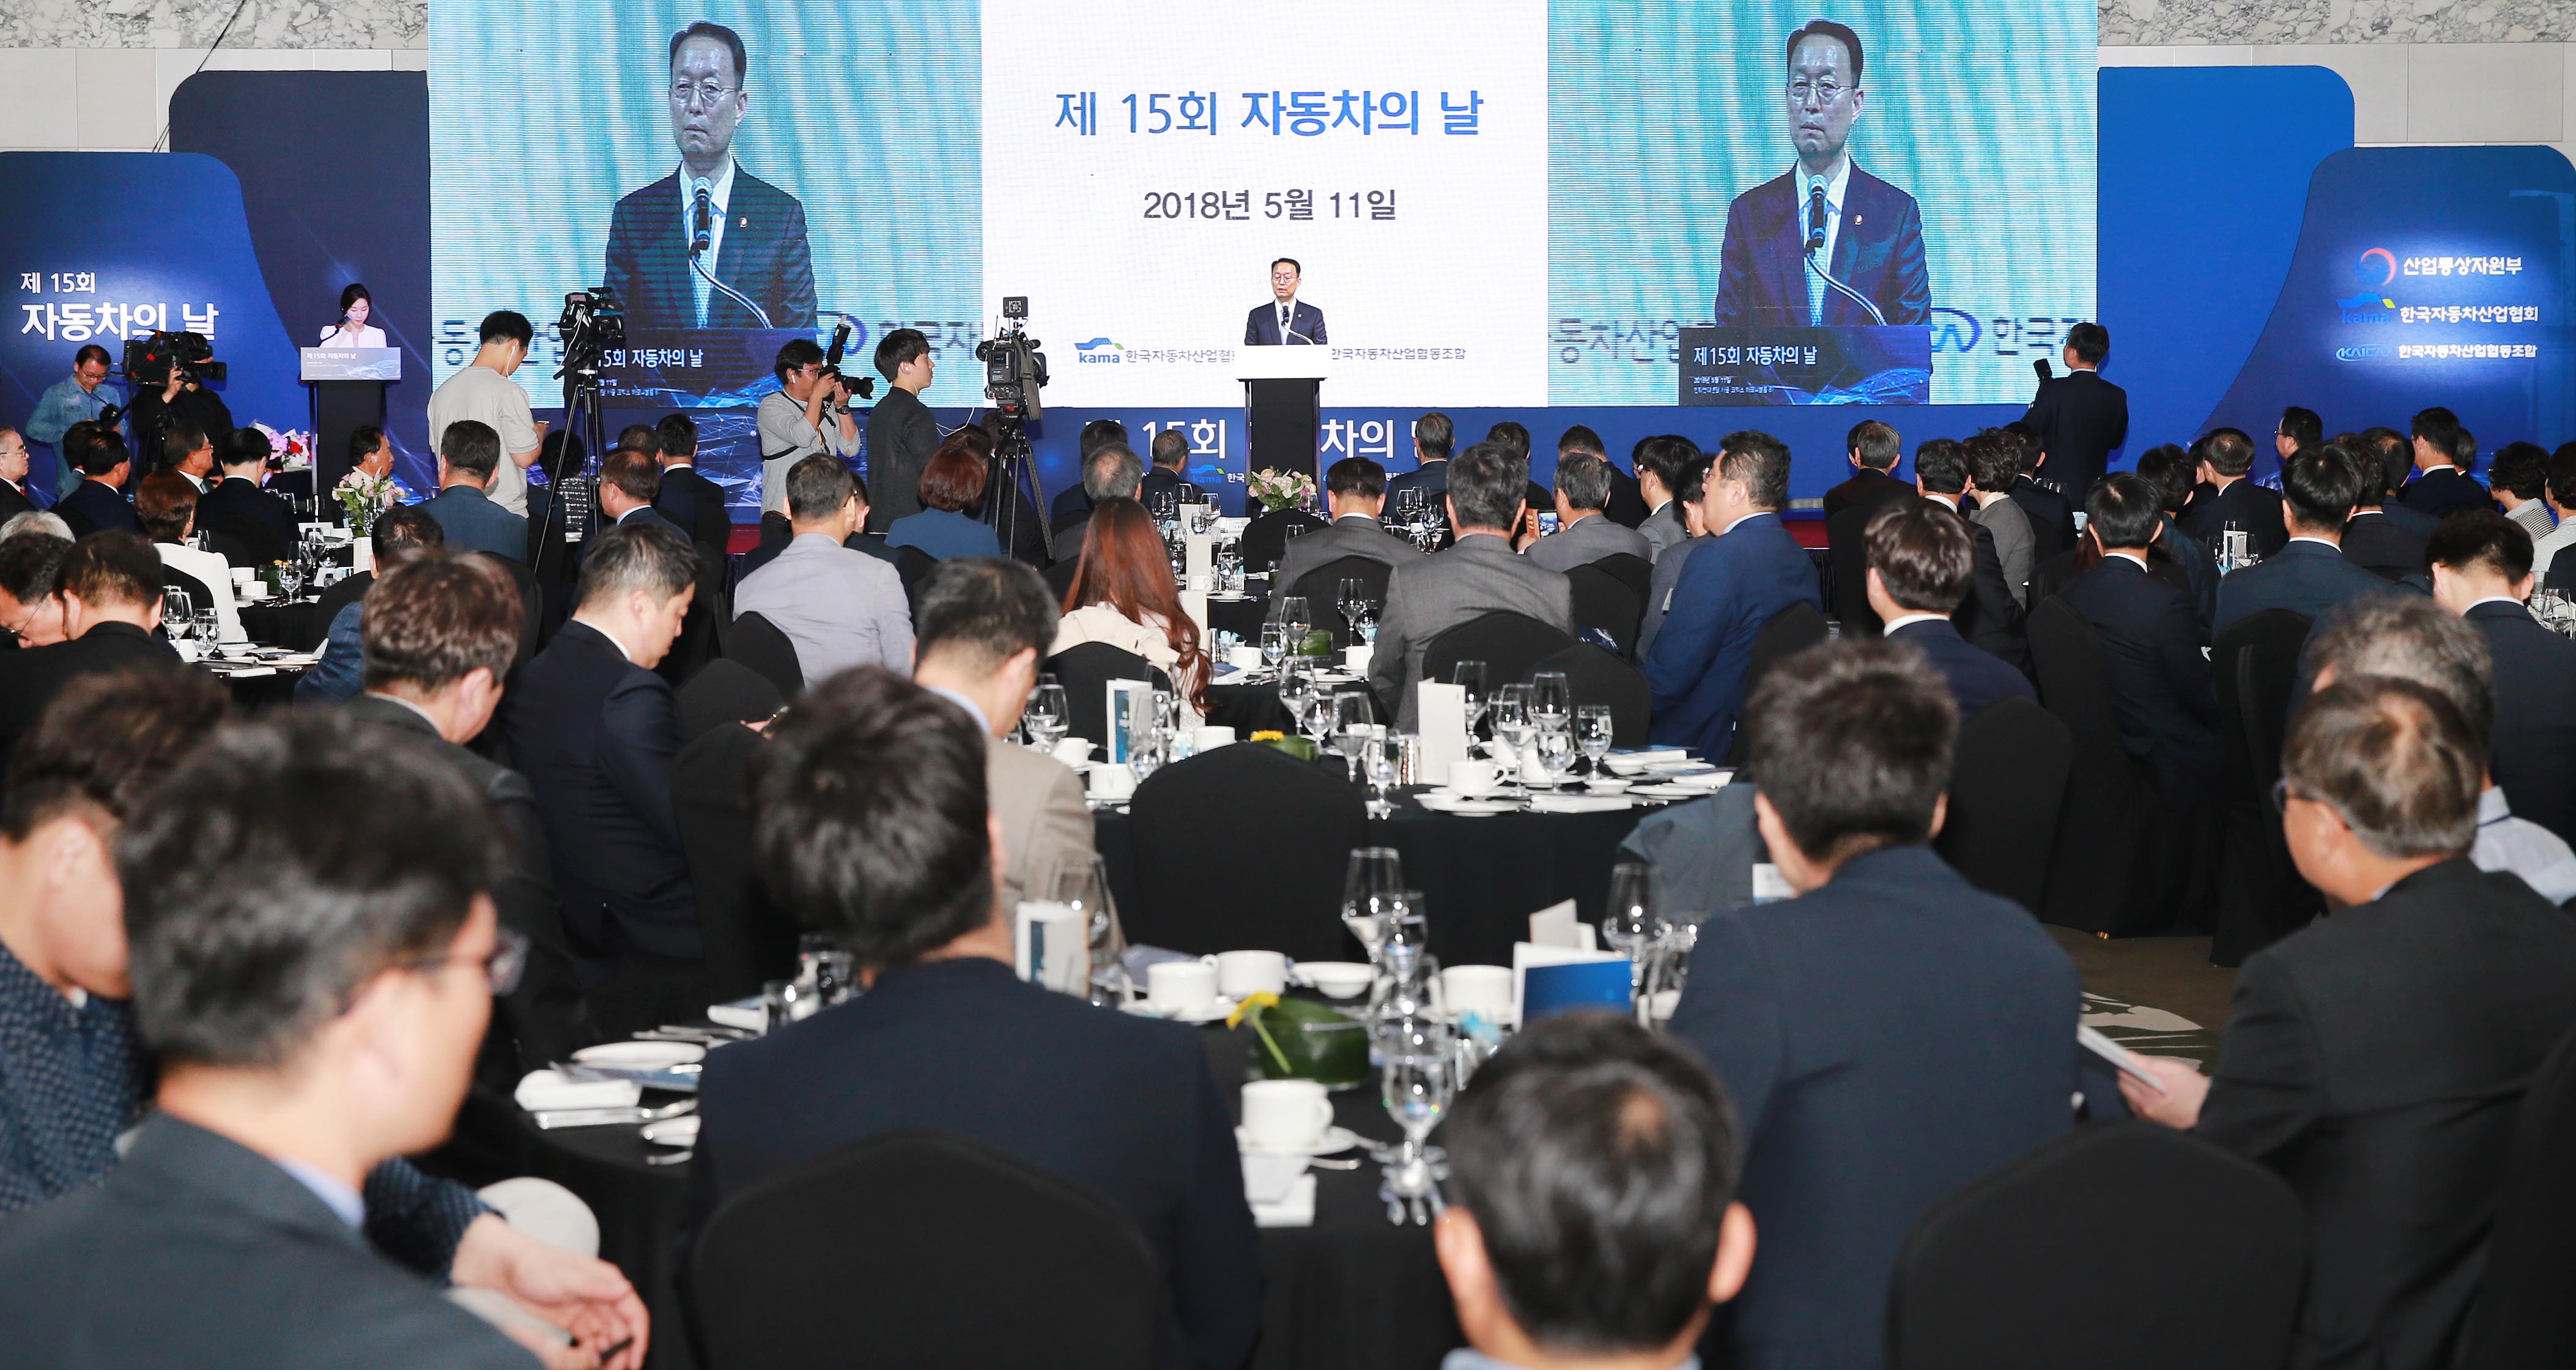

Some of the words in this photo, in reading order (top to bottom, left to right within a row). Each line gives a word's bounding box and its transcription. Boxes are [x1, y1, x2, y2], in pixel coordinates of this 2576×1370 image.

[1054, 91, 1097, 136] 제
[1122, 91, 1217, 136] 15회
[1240, 89, 1419, 137] 자동차의
[1440, 90, 1484, 135] 날
[1143, 188, 1251, 221] 2018년
[1264, 189, 1314, 221] 5월
[1329, 189, 1396, 221] 11일
[2402, 256, 2523, 277] 산업통상자원부
[20, 272, 42, 294] 제
[50, 272, 96, 295] 15회
[20, 301, 167, 342] 자동차의
[2342, 311, 2391, 324] kama
[2399, 305, 2539, 324] 한국자동차산업협회
[631, 349, 685, 368] 자동차의
[689, 349, 705, 368] 날
[1078, 352, 1120, 363] kama
[1124, 349, 1235, 363] 한국자동차산업협
[1746, 346, 1799, 365] 자동차의
[1804, 346, 1818, 365] 날
[2397, 344, 2538, 360] 한국자동차산업협동조합
[1193, 475, 1222, 484] kama
